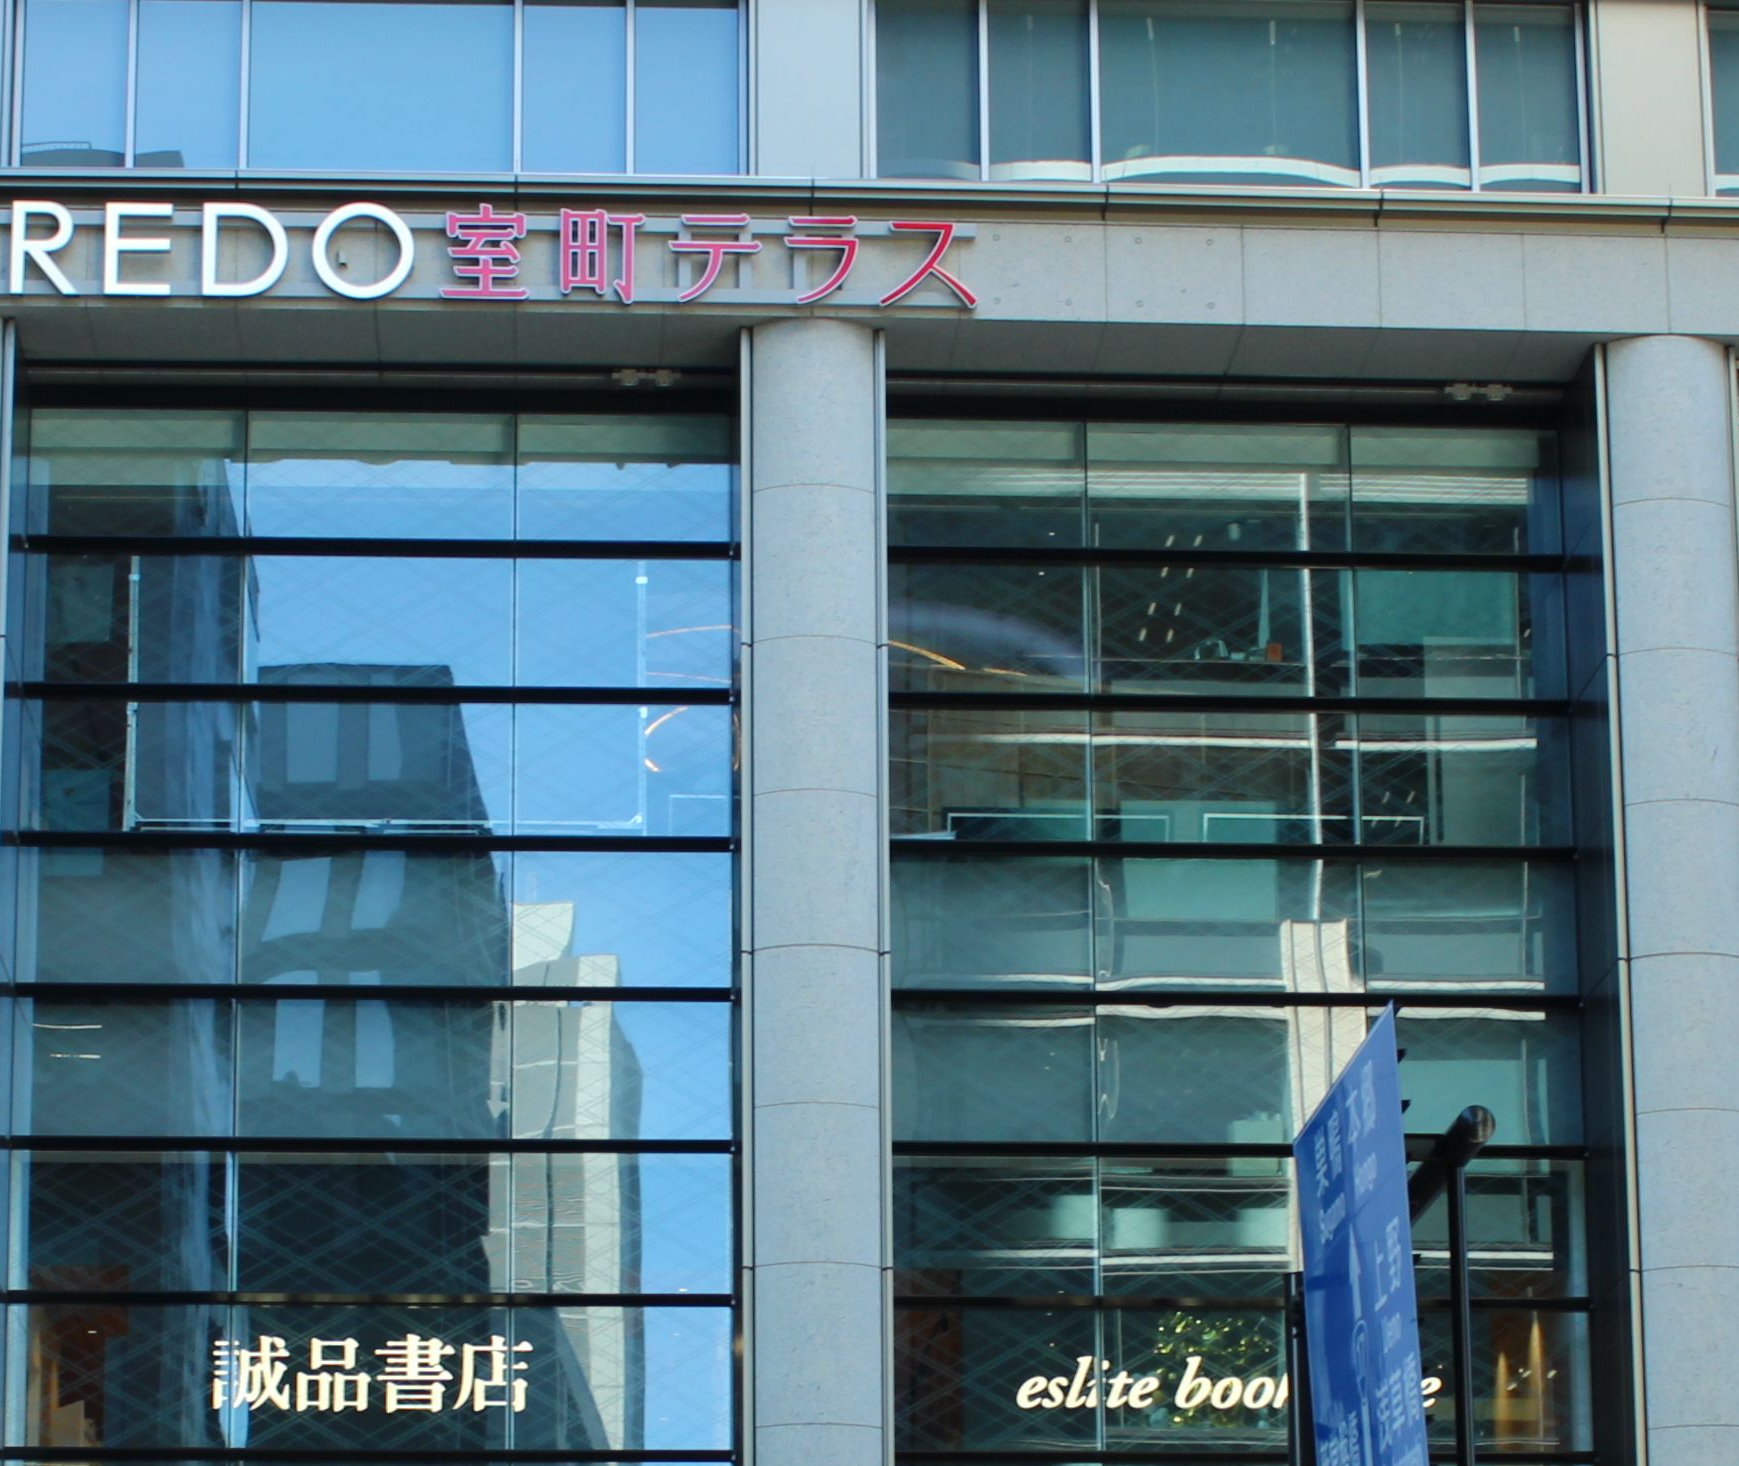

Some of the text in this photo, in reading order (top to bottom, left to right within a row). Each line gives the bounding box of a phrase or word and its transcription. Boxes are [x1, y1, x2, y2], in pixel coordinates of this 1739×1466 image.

[438, 203, 979, 308] 室町テラス
[1374, 1215, 1402, 1313] 上野
[211, 1333, 535, 1414] 誠品書店
[1015, 1355, 1160, 1410] eslite
